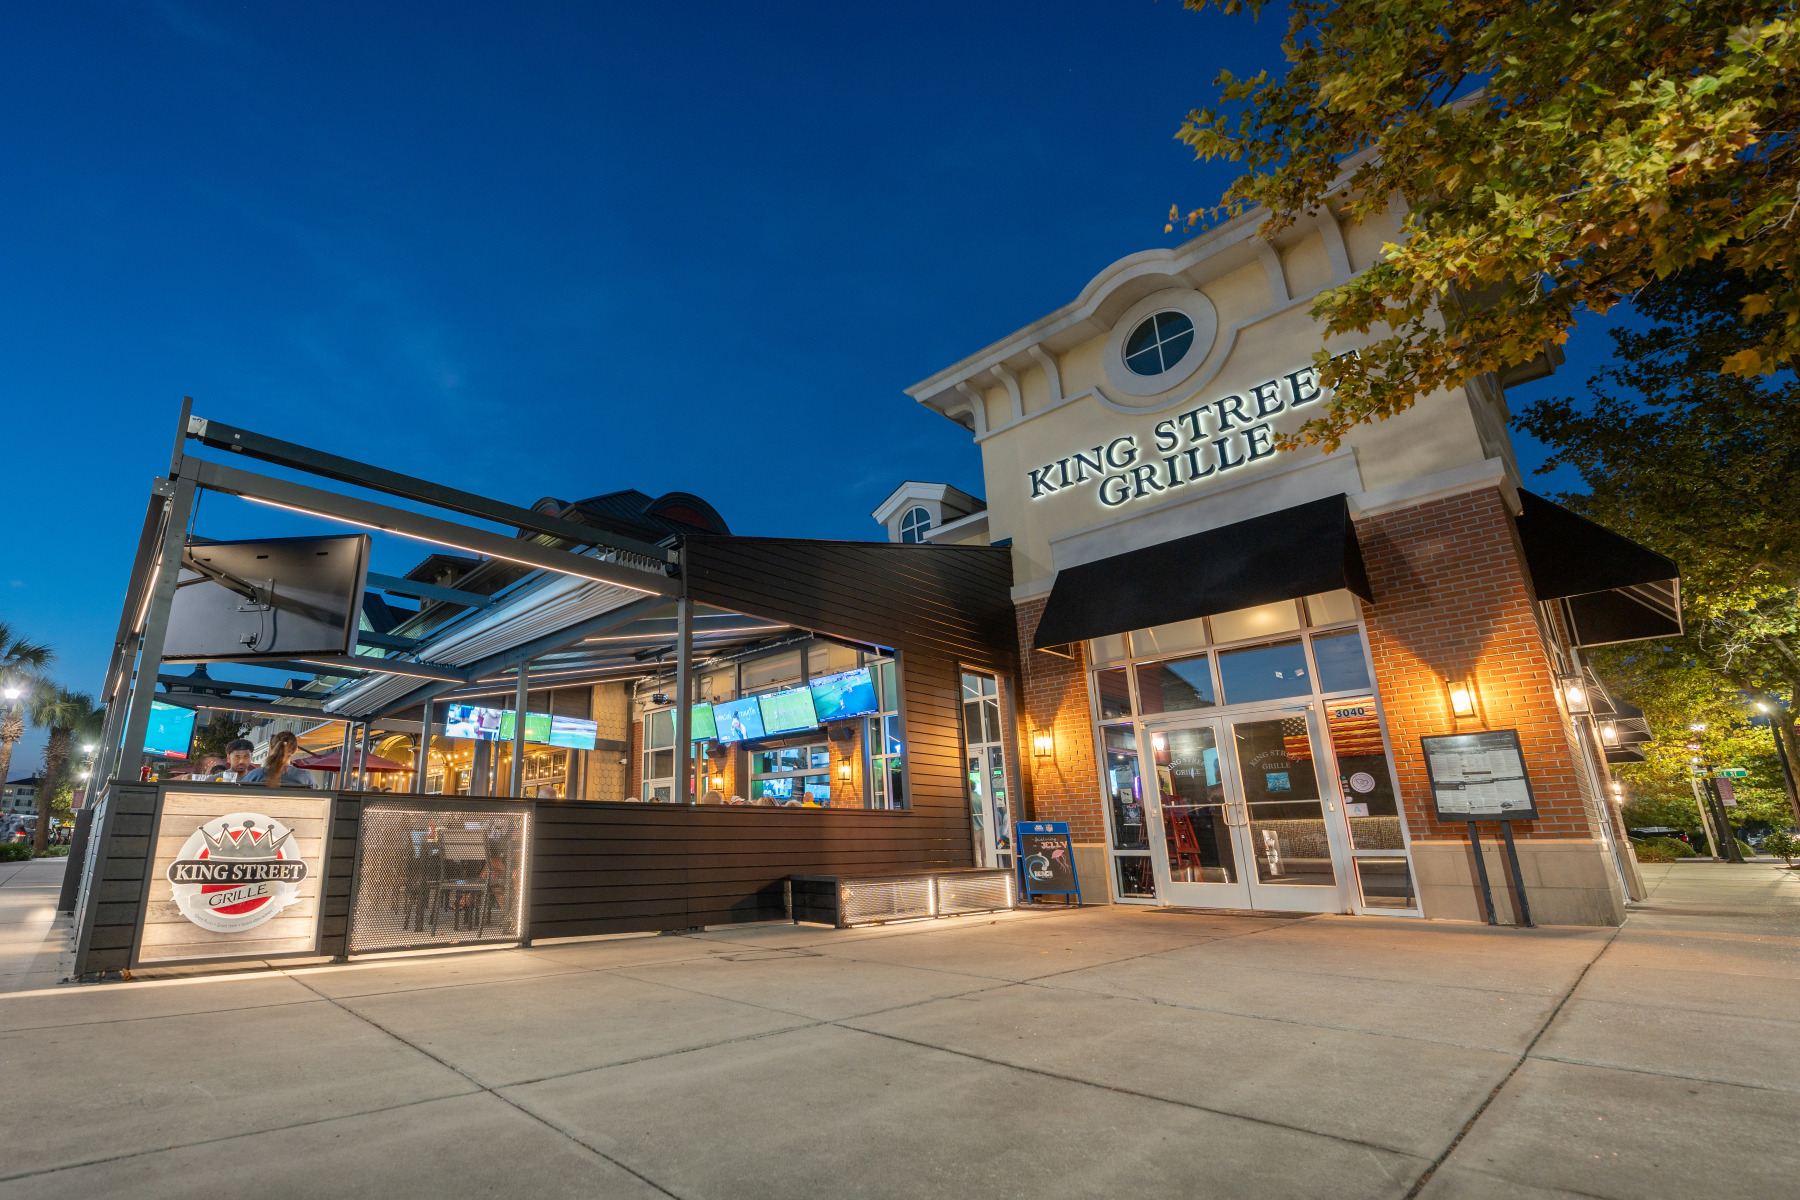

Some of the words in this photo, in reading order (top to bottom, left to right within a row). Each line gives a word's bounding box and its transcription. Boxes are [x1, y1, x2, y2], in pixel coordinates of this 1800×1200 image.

[1027, 436, 1138, 499] KING
[1154, 350, 1360, 452] STREE
[1100, 423, 1276, 508] GRILLE
[1335, 707, 1365, 718] 3040
[1250, 751, 1269, 767] KING
[1270, 750, 1303, 763] STREET
[1262, 762, 1292, 770] GRILLE
[1353, 805, 1362, 813] A
[1041, 841, 1068, 849] JELLY
[174, 864, 229, 881] KING
[231, 864, 304, 881] STREET
[208, 883, 269, 907] GRILLE
